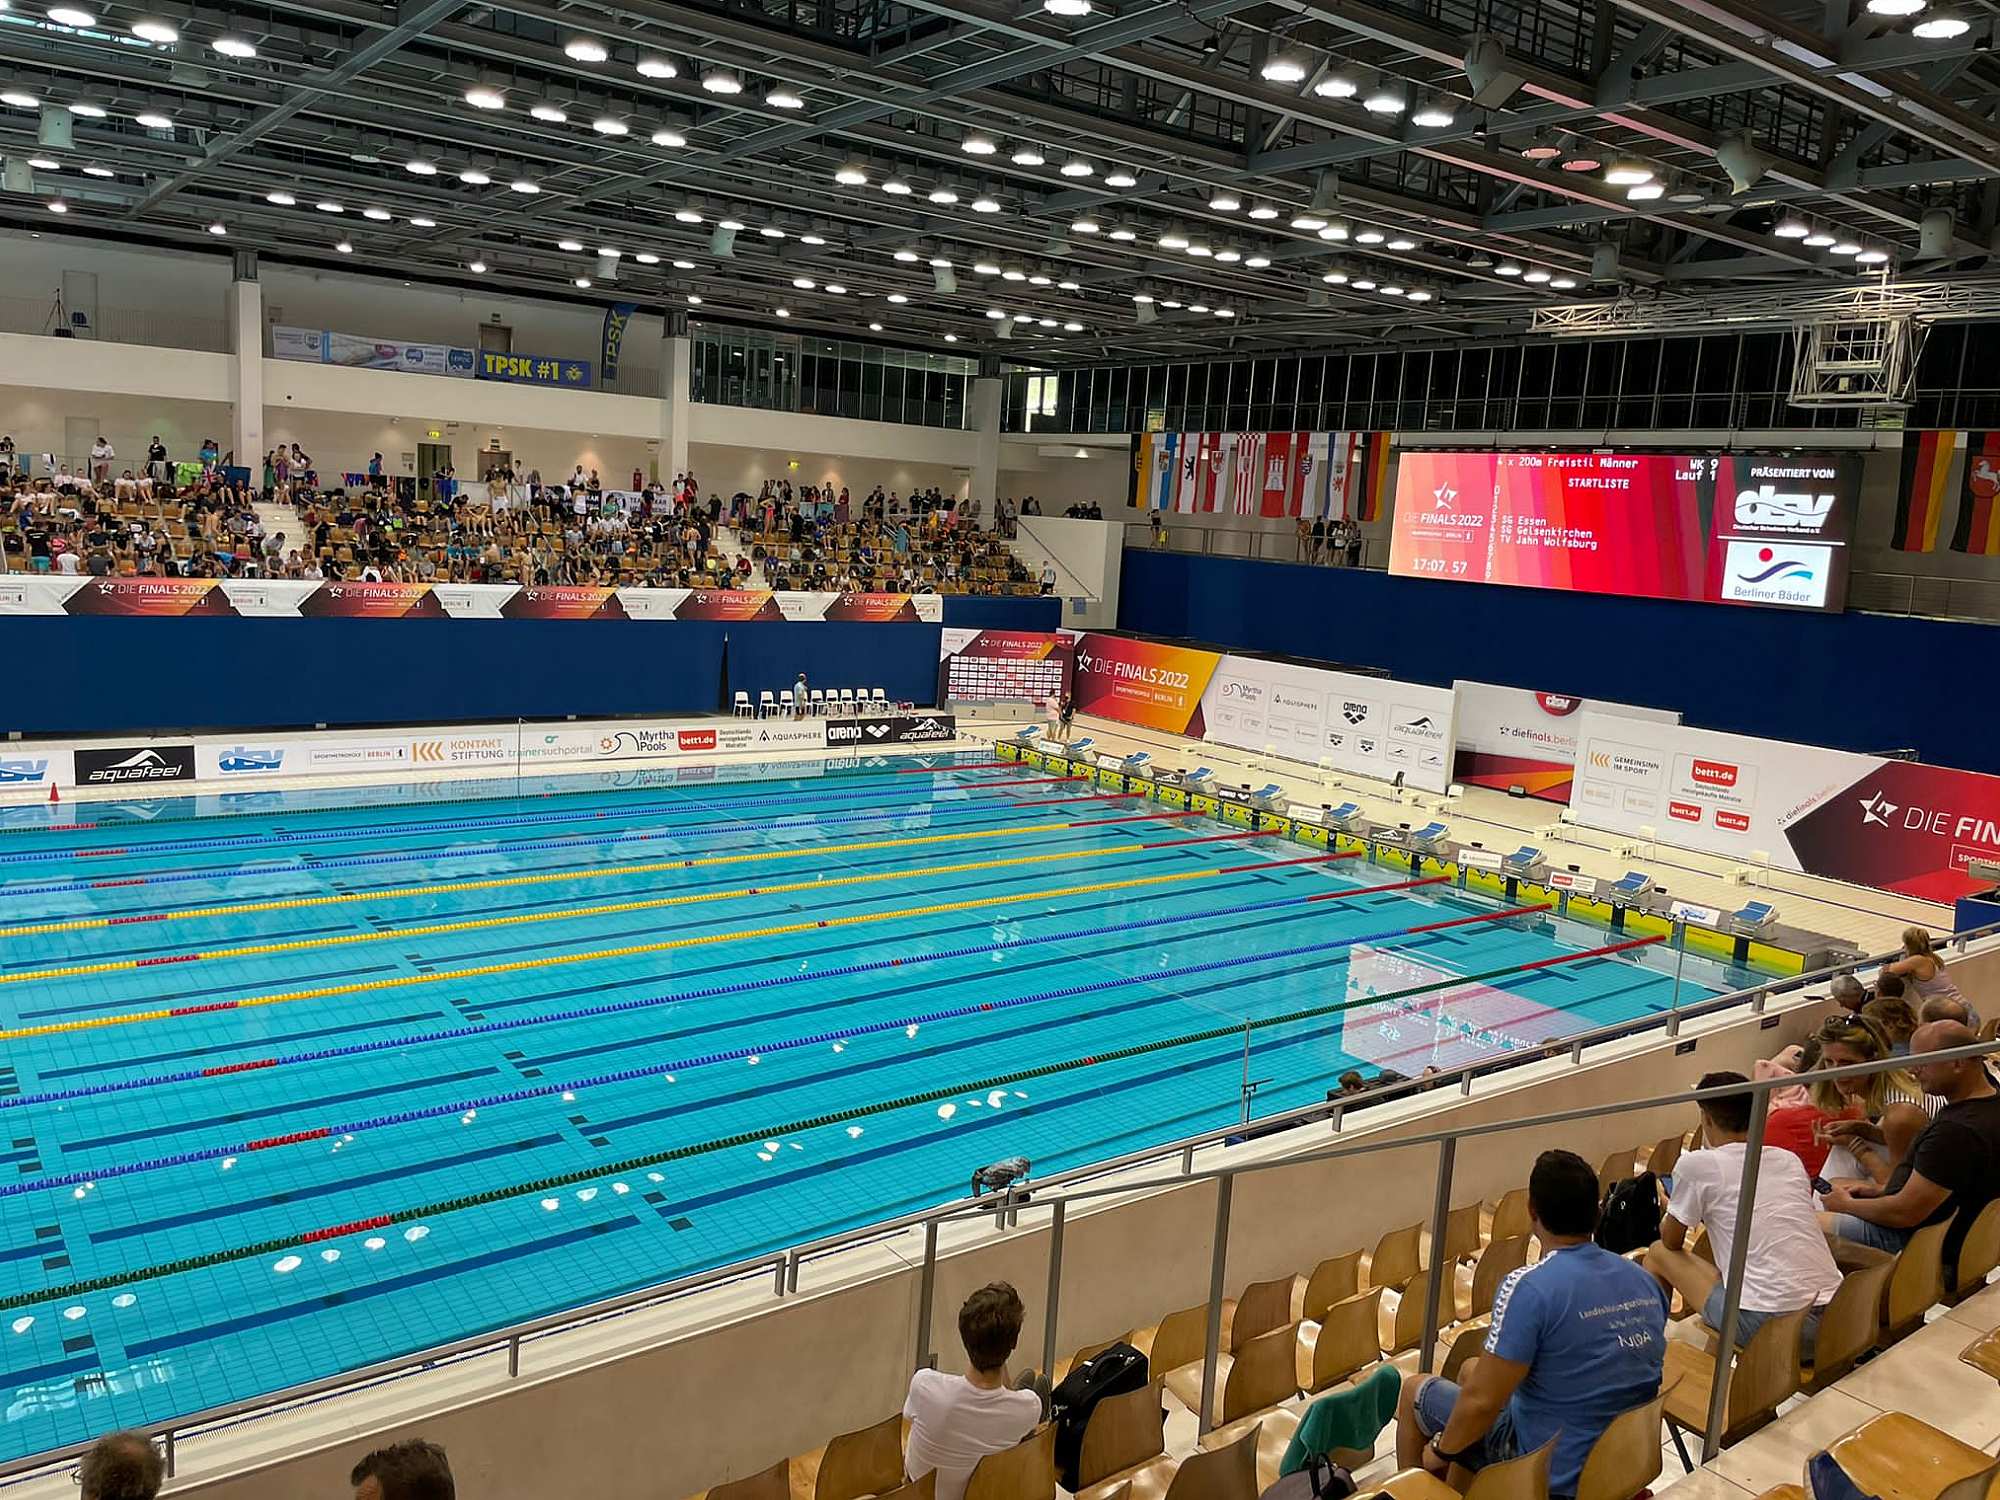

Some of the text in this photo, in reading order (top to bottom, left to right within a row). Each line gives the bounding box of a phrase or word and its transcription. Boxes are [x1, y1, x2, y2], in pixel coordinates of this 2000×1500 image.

[606, 309, 627, 369] TPSK
[484, 354, 533, 377] TPSK
[537, 361, 559, 380] #1
[1519, 456, 1542, 467] 200m
[1547, 457, 1594, 468] Freistil
[1600, 457, 1639, 469] Männer
[1690, 459, 1718, 469] WK 9
[1675, 470, 1717, 481] Lauf 1
[1751, 467, 1835, 479] PRÄSENTIERT VON
[1567, 478, 1630, 489] STARTLISTE
[1421, 512, 1457, 525] FINALS
[1457, 514, 1484, 527] 2022
[1518, 516, 1547, 526] Essen
[1517, 526, 1593, 539] Gelsenkirchen
[1500, 534, 1511, 543] TV
[1516, 536, 1539, 545] Jahn
[1544, 538, 1597, 551] Wolfsburg
[1452, 561, 1468, 574] 57
[118, 585, 208, 595] DIE FINALS 2022
[363, 588, 398, 598] FINALS
[400, 588, 423, 598] 2022
[1734, 586, 1811, 602] Berliner Bäder
[556, 593, 586, 601] FINALS
[722, 595, 748, 604] FINALS
[1002, 641, 1026, 649] FINALS
[1095, 658, 1189, 688] DIE FINALS 2022
[1343, 702, 1368, 714] arena
[639, 730, 675, 742] Myrtha
[772, 732, 822, 740] AQUASPHERE
[827, 725, 862, 740] arena
[899, 729, 949, 742] aquafeel
[1394, 724, 1443, 739] aquafeel
[450, 738, 503, 750] KONTAKT
[640, 741, 667, 751] Pools
[680, 737, 714, 745] bett1.de
[451, 749, 504, 761] STIFTUNG
[508, 745, 592, 758] trainersuchportal
[1614, 756, 1660, 770] GEMEINSINN
[89, 764, 182, 783] aquafeel
[1624, 766, 1649, 776] SPORT
[1695, 766, 1735, 781] bett1.de
[1903, 807, 1951, 835] DIE
